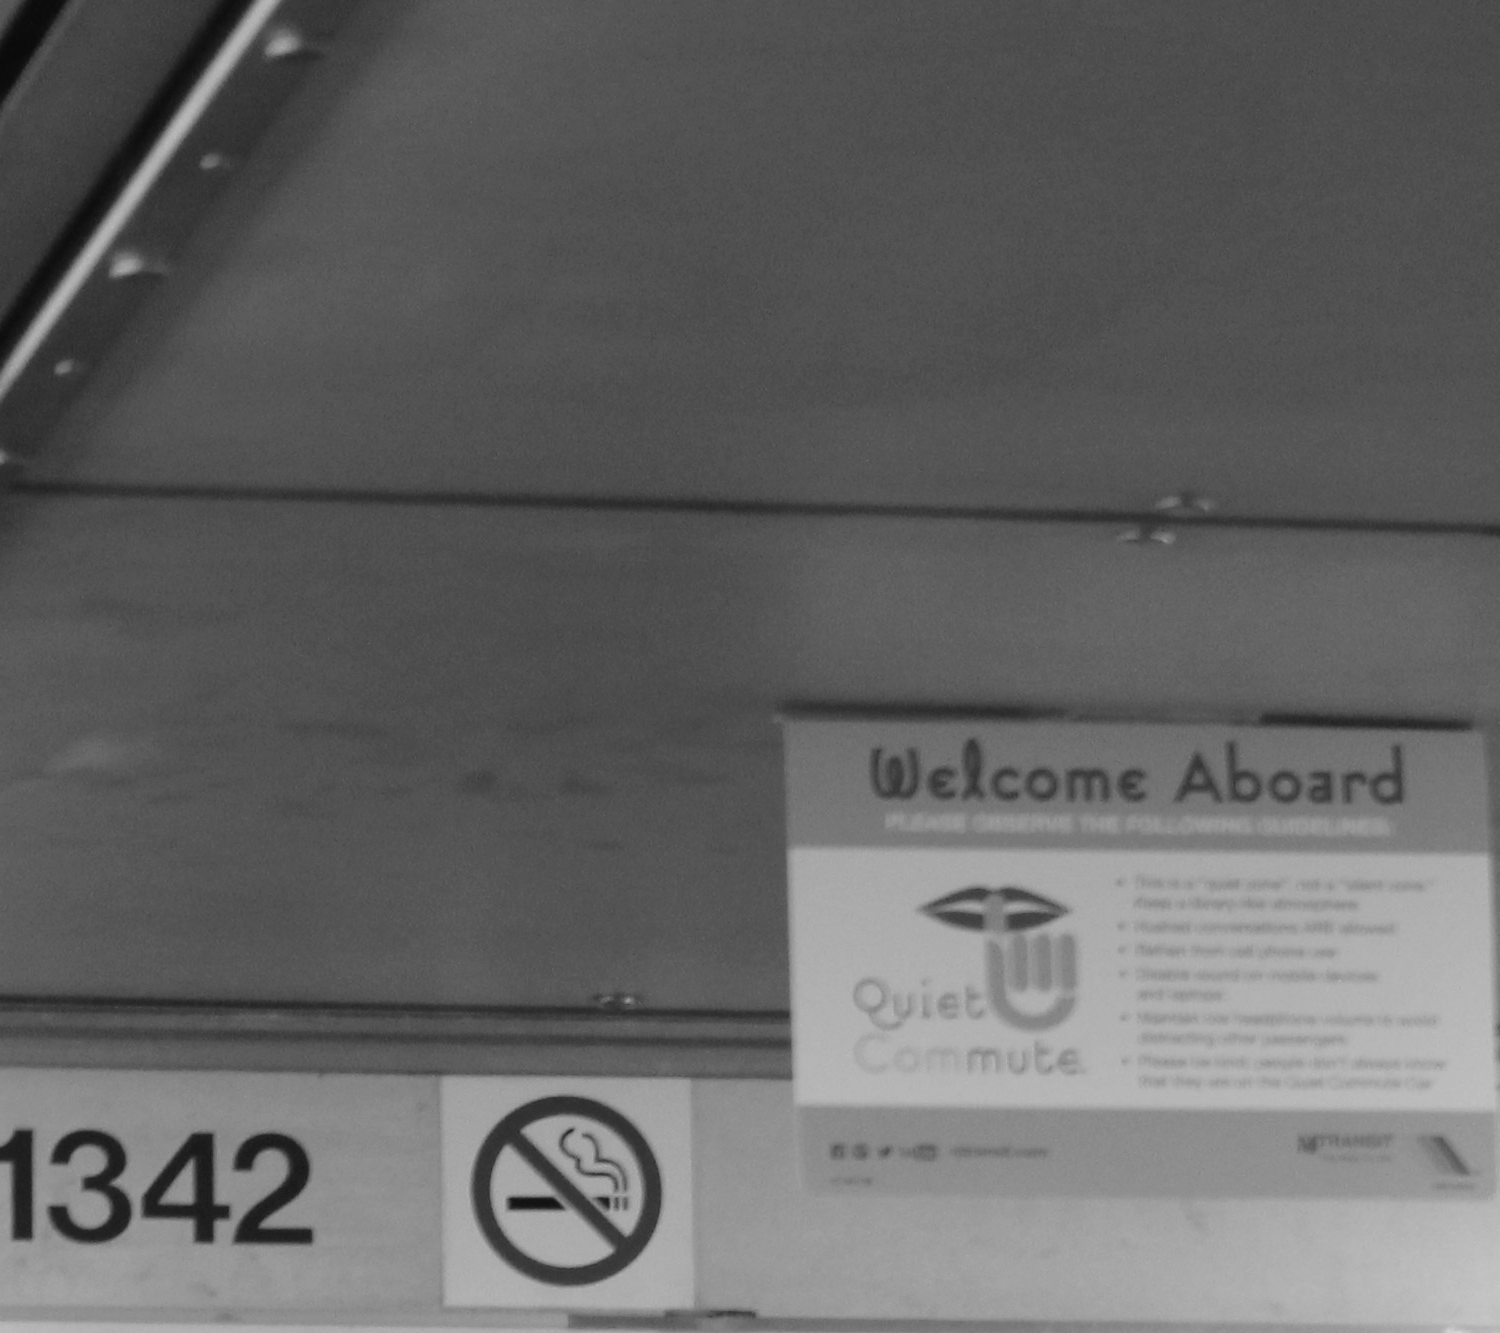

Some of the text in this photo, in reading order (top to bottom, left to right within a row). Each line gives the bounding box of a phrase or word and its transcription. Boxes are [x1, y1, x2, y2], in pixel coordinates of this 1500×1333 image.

[868, 737, 1406, 807] Welcome Aboard
[852, 976, 986, 1031] Quiet
